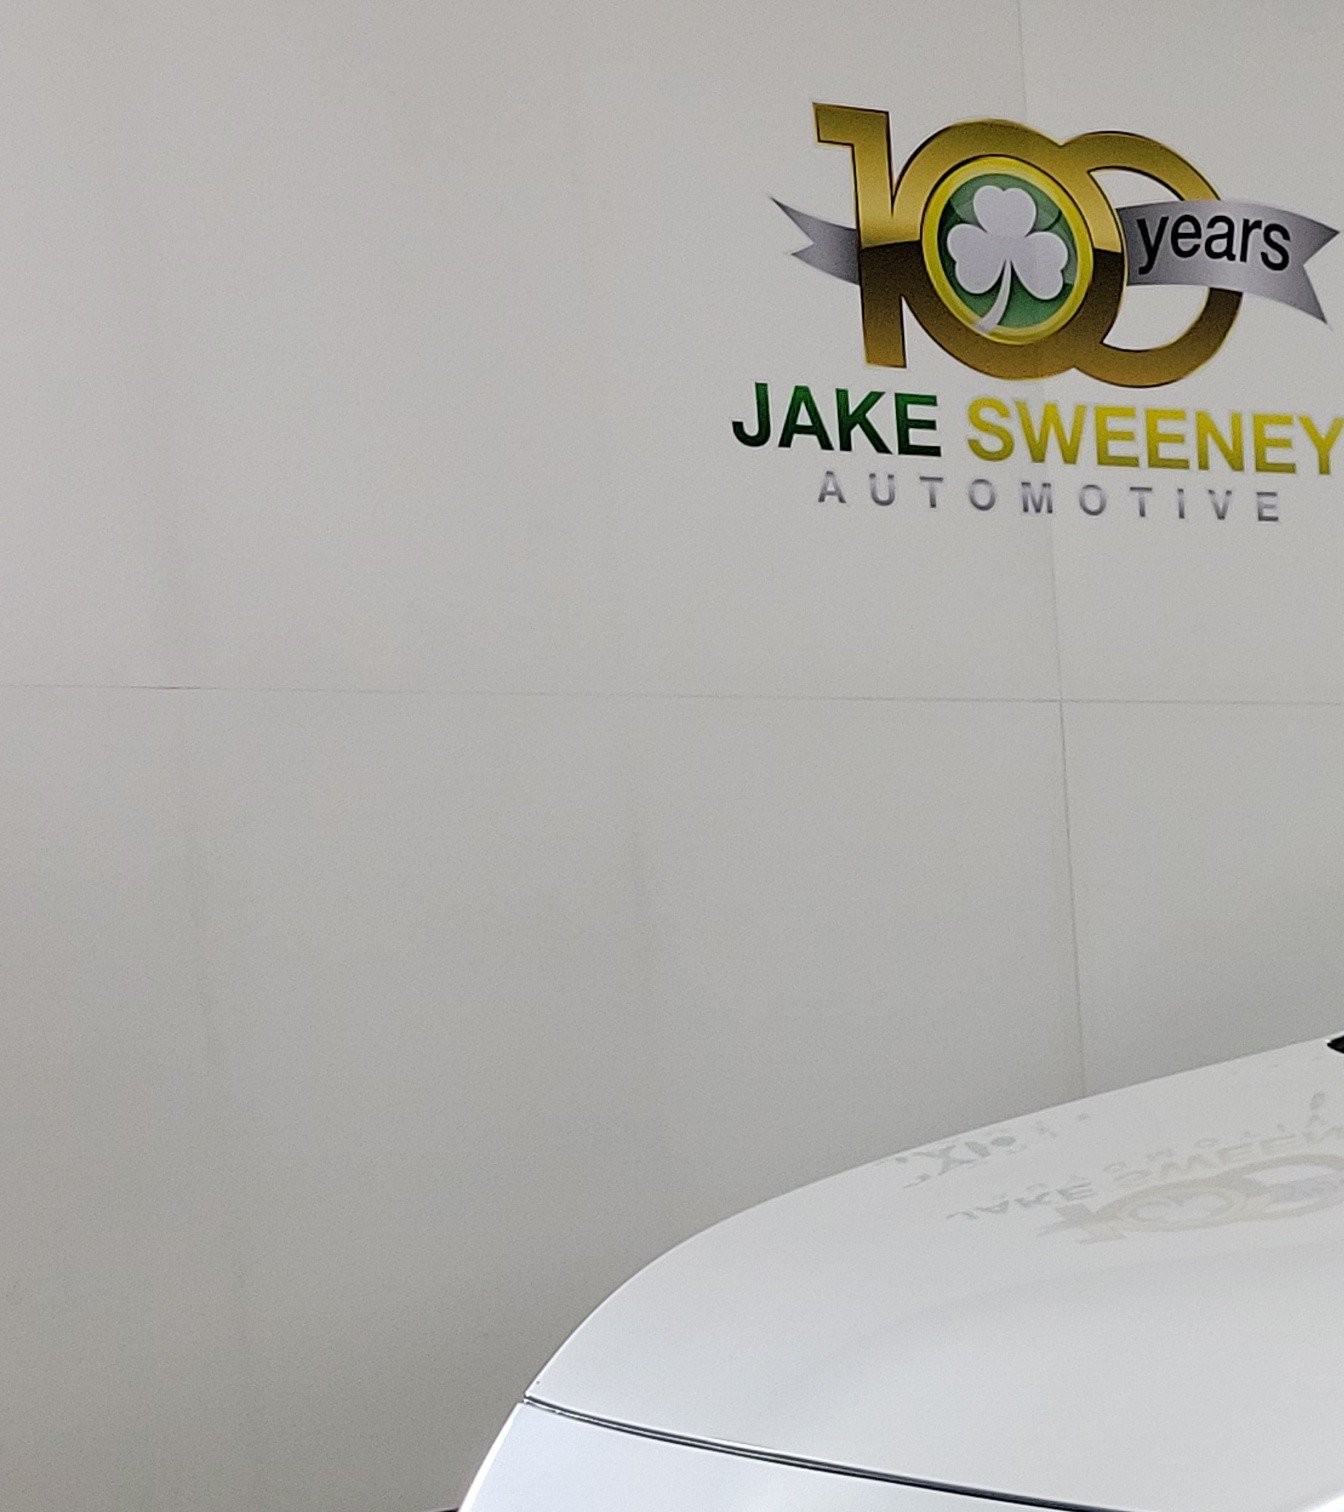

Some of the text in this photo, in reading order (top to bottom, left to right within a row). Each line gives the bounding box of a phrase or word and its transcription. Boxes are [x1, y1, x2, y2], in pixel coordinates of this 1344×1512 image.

[1136, 213, 1291, 274] years
[732, 381, 942, 458] JAKE
[817, 469, 1280, 522] AUTOMOTIVE
